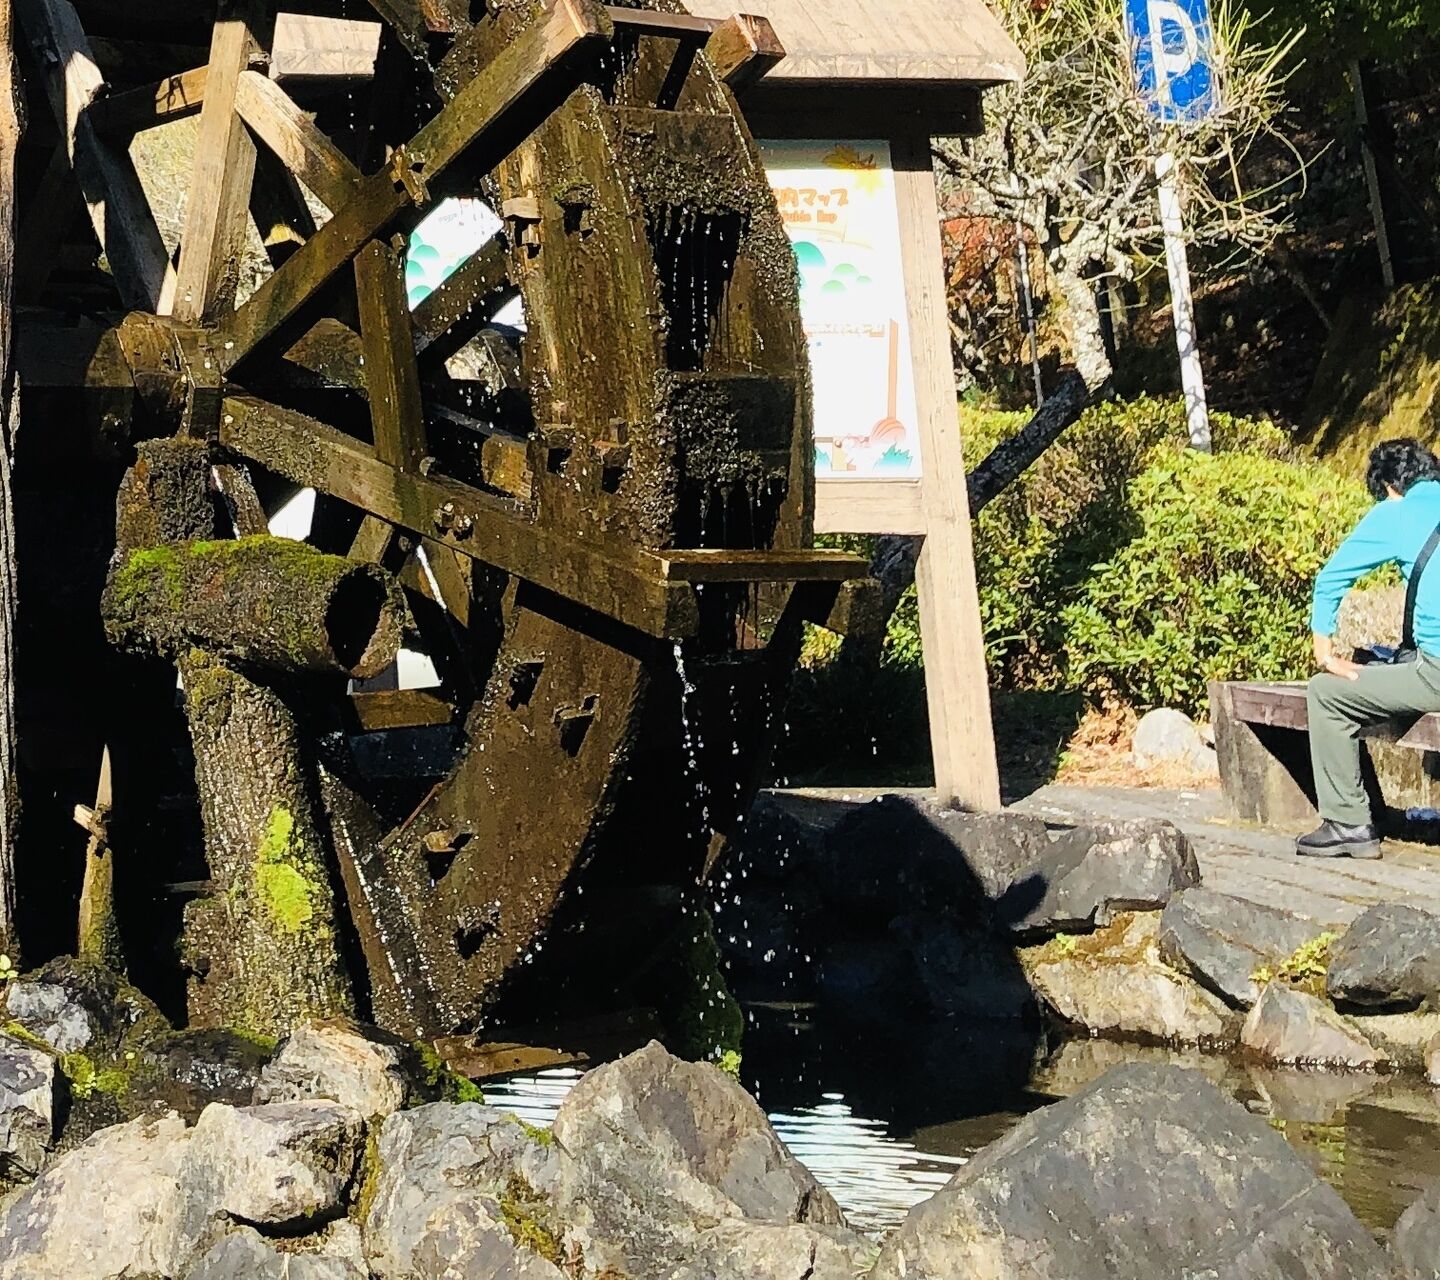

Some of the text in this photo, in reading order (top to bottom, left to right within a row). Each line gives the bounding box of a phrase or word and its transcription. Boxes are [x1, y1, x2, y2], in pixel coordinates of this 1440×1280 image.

[1147, 0, 1198, 105] P
[771, 187, 849, 207] 内マップ
